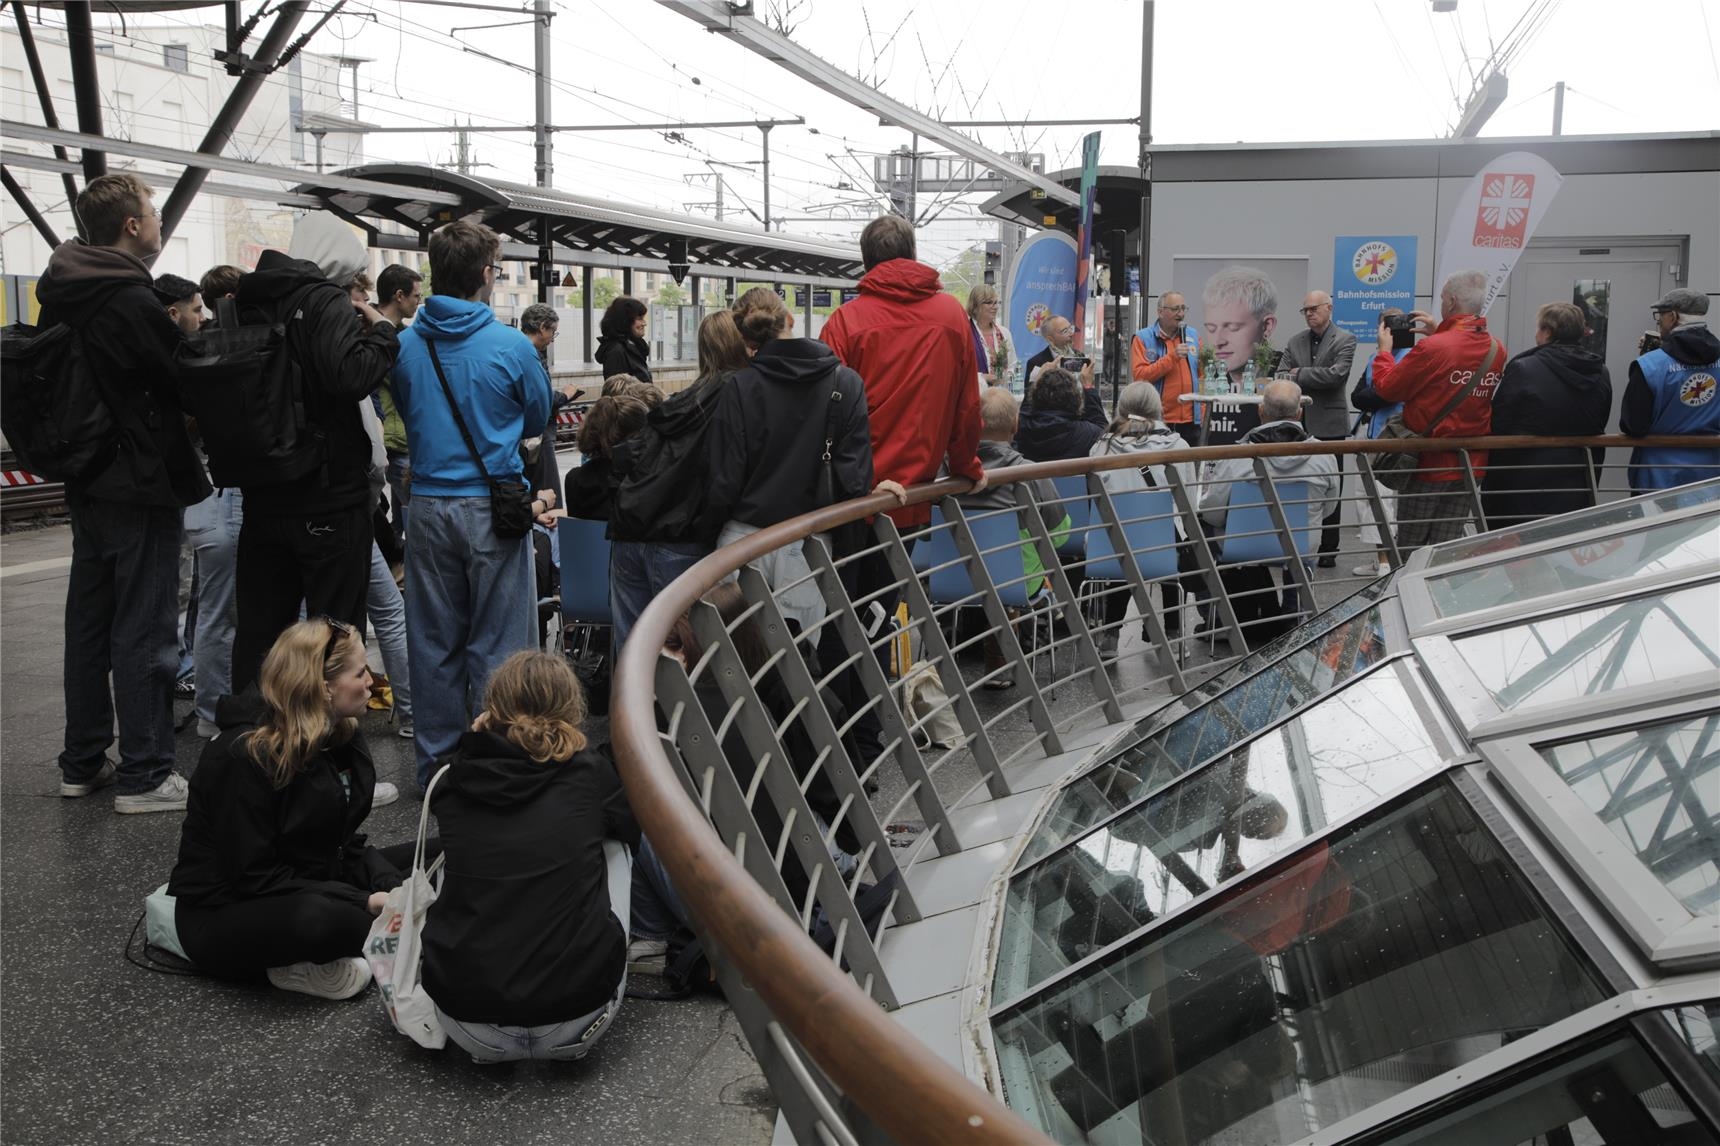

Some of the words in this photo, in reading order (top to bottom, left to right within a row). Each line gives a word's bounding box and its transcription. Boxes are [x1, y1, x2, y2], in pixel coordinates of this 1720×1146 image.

[1474, 234, 1521, 249] caritas
[1355, 243, 1387, 268] BAHNHOFS
[1368, 263, 1395, 283] MISSION
[1337, 290, 1411, 299] Bahnhofsmission
[1361, 301, 1386, 310] Erfurt
